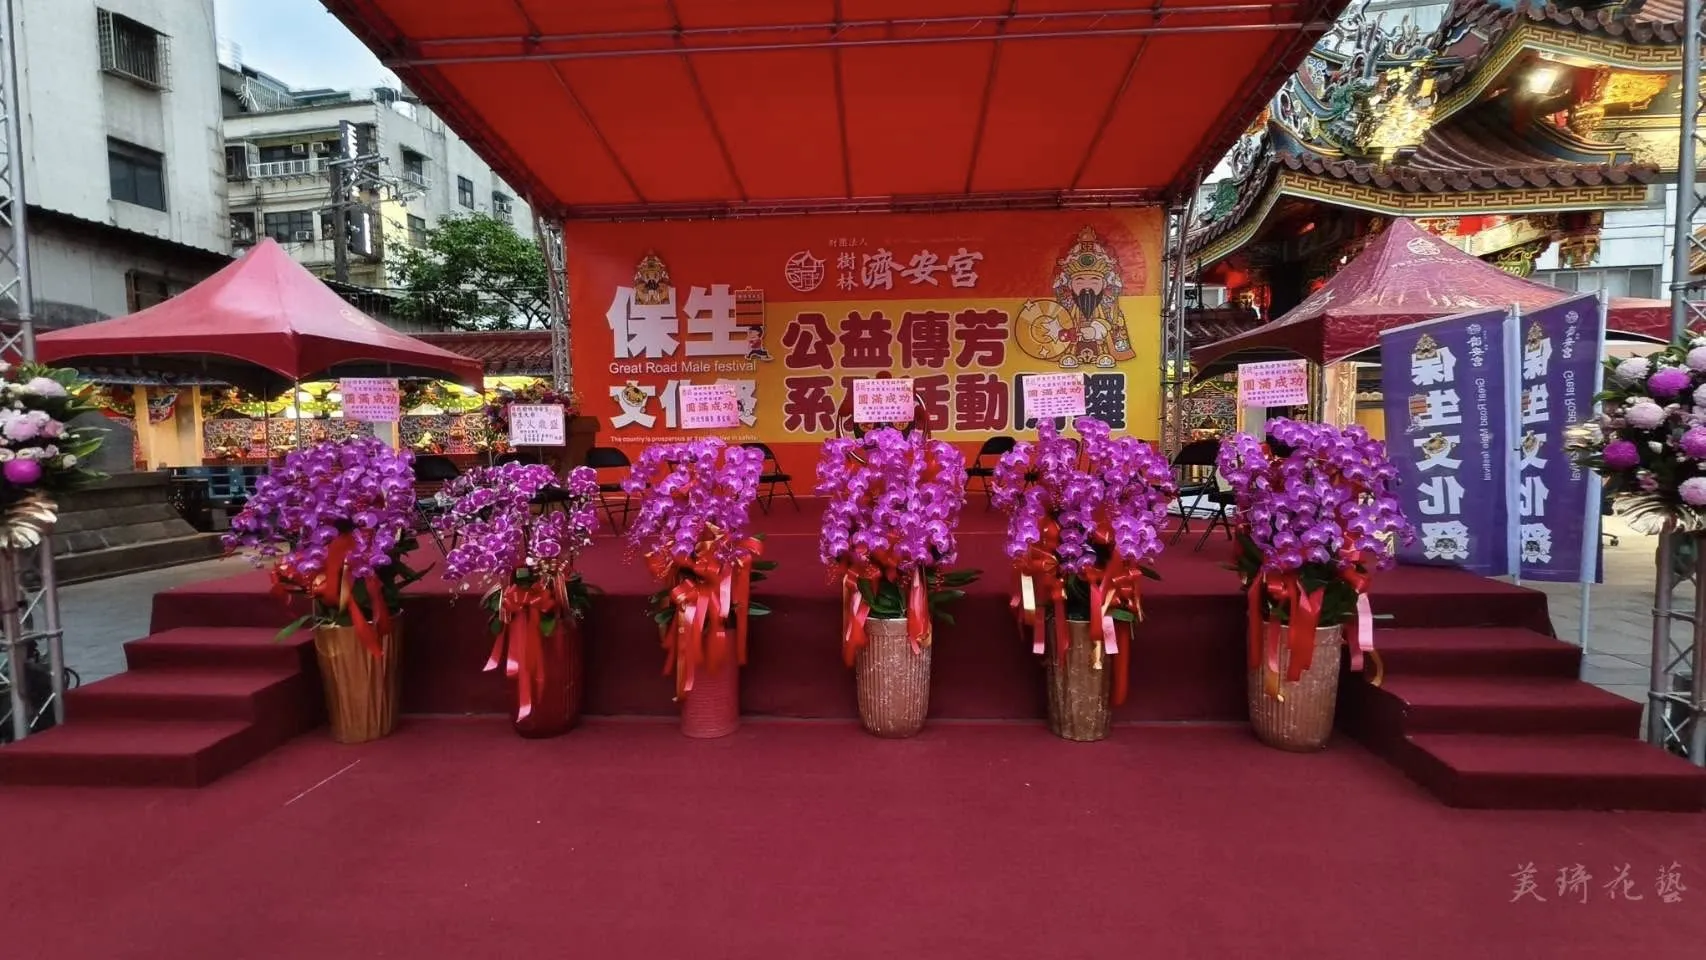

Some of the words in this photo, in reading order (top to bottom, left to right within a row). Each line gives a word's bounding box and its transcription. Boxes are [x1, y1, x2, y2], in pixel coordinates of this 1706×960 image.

[836, 251, 859, 291] 樹林
[861, 247, 984, 290] 濟安宮
[606, 284, 752, 358] 保生
[782, 309, 1010, 370] 公益傳芳
[609, 362, 643, 374] Great
[646, 362, 678, 373] Road
[682, 361, 711, 372] Male
[714, 361, 758, 372] festival
[1243, 375, 1304, 391] 圓滿成功
[345, 393, 397, 405] 圓滿成功
[858, 393, 911, 405] 圓滿成功
[1027, 387, 1082, 398] 圓滿成功
[686, 401, 734, 413] 圓滿成功
[784, 372, 1127, 433] 系活動鑼
[622, 436, 645, 444] country
